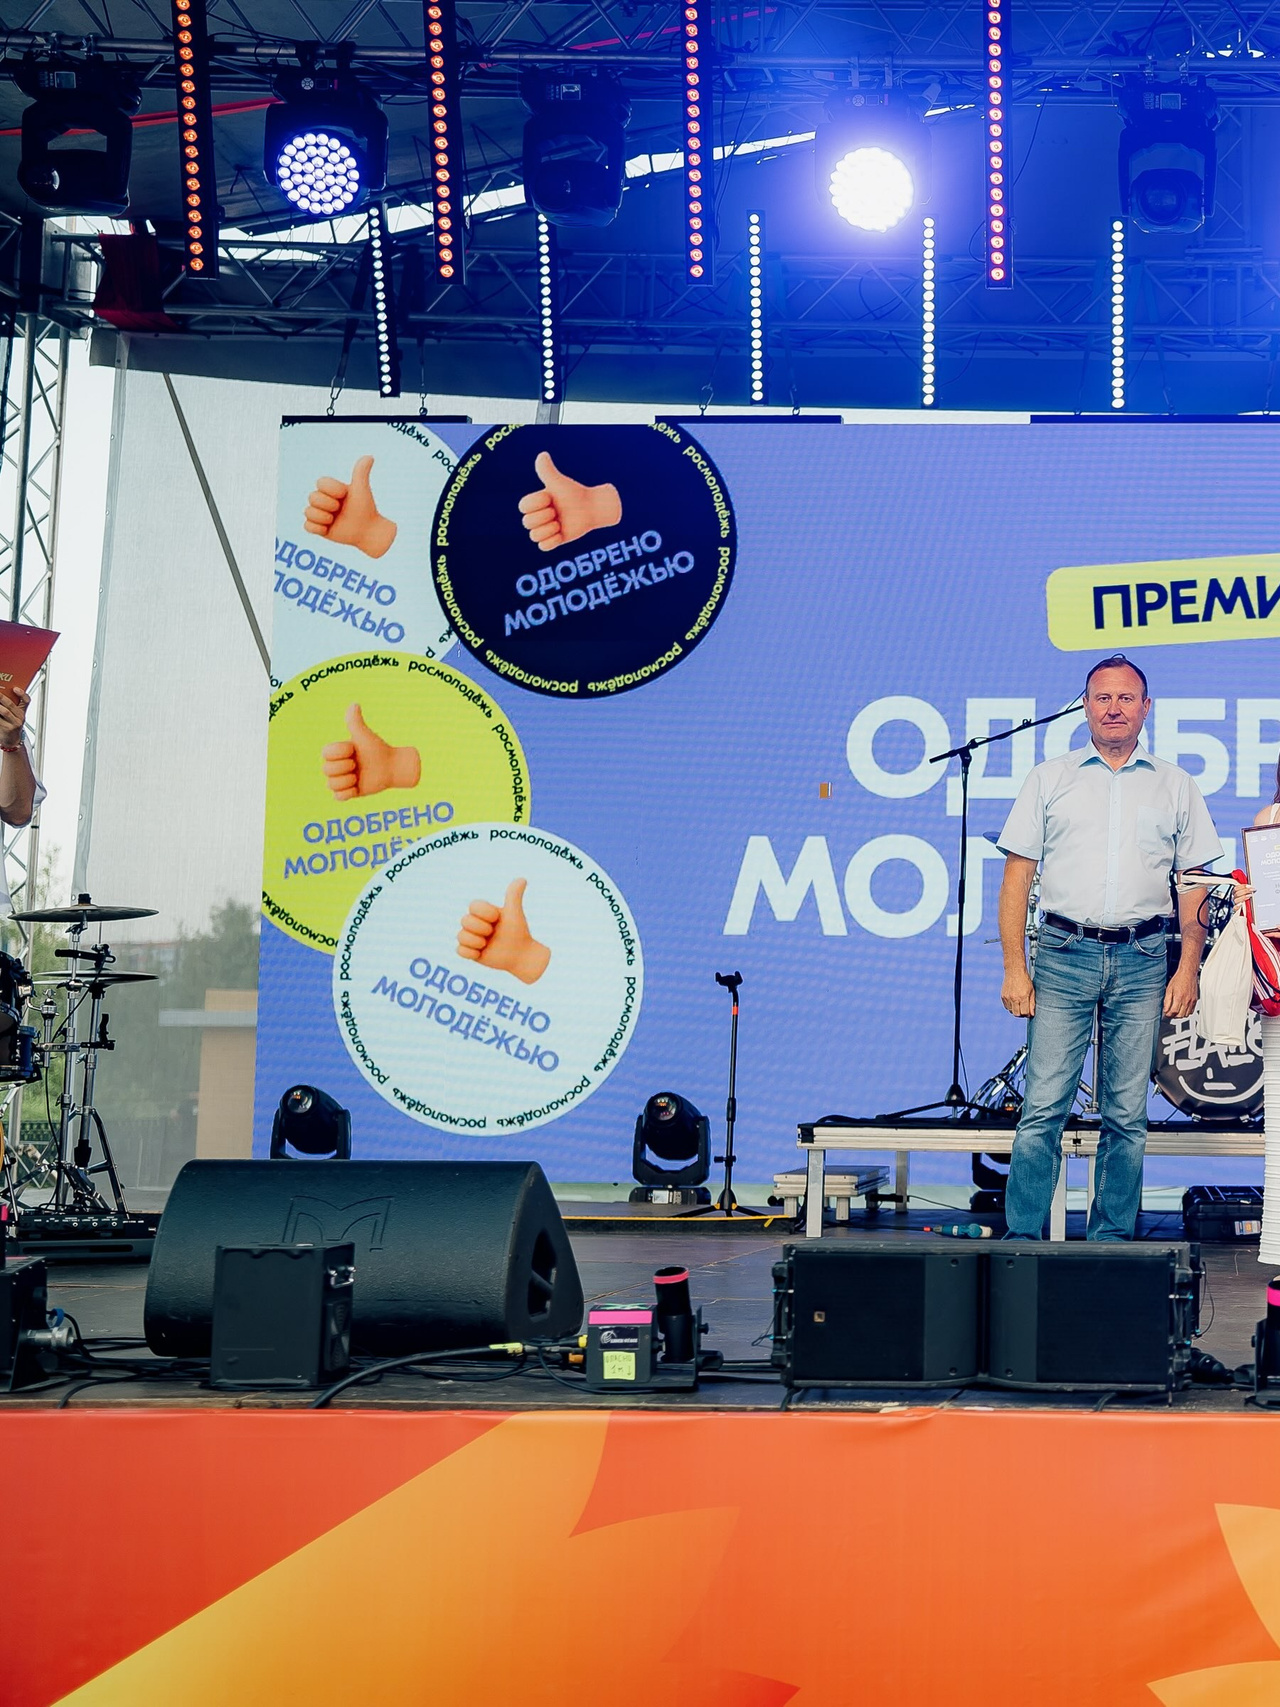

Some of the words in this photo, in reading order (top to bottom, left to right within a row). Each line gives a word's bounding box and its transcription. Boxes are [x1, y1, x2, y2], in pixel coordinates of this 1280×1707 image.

[437, 454, 482, 546] росмолодёжь
[683, 445, 730, 538] росмолодёжь
[275, 537, 397, 606] ДОБРЕНО
[437, 555, 484, 648] росмолодёжь
[504, 551, 695, 637] МОЛОДЁЖЬЮ
[515, 530, 662, 597] ОДОБРЕНО
[685, 547, 730, 641] росмолодёжь
[274, 569, 405, 643] ЛОДЁЖЬЮ
[485, 650, 578, 693] росмолодёжь
[588, 642, 683, 692] росмолодёжь
[300, 655, 399, 691] росмолодёжь
[408, 660, 493, 719] росмолодёжь
[492, 723, 526, 822] росмолодёжь
[303, 801, 454, 845] ОДОБРЕНО
[385, 831, 480, 882] росмолодёжь
[489, 829, 584, 870] росмолодёжь
[340, 884, 382, 980] росмолодёжь
[586, 872, 635, 966] росмолодёжь
[371, 975, 559, 1072] МОЛОДЁЖЬЮ
[409, 957, 551, 1034] ОДОБРЕНО
[594, 976, 636, 1073] росмолодёжь
[341, 991, 390, 1084] росмолодёжь
[392, 1086, 487, 1128] росмолодёжь
[496, 1075, 591, 1127] росмолодёжь
